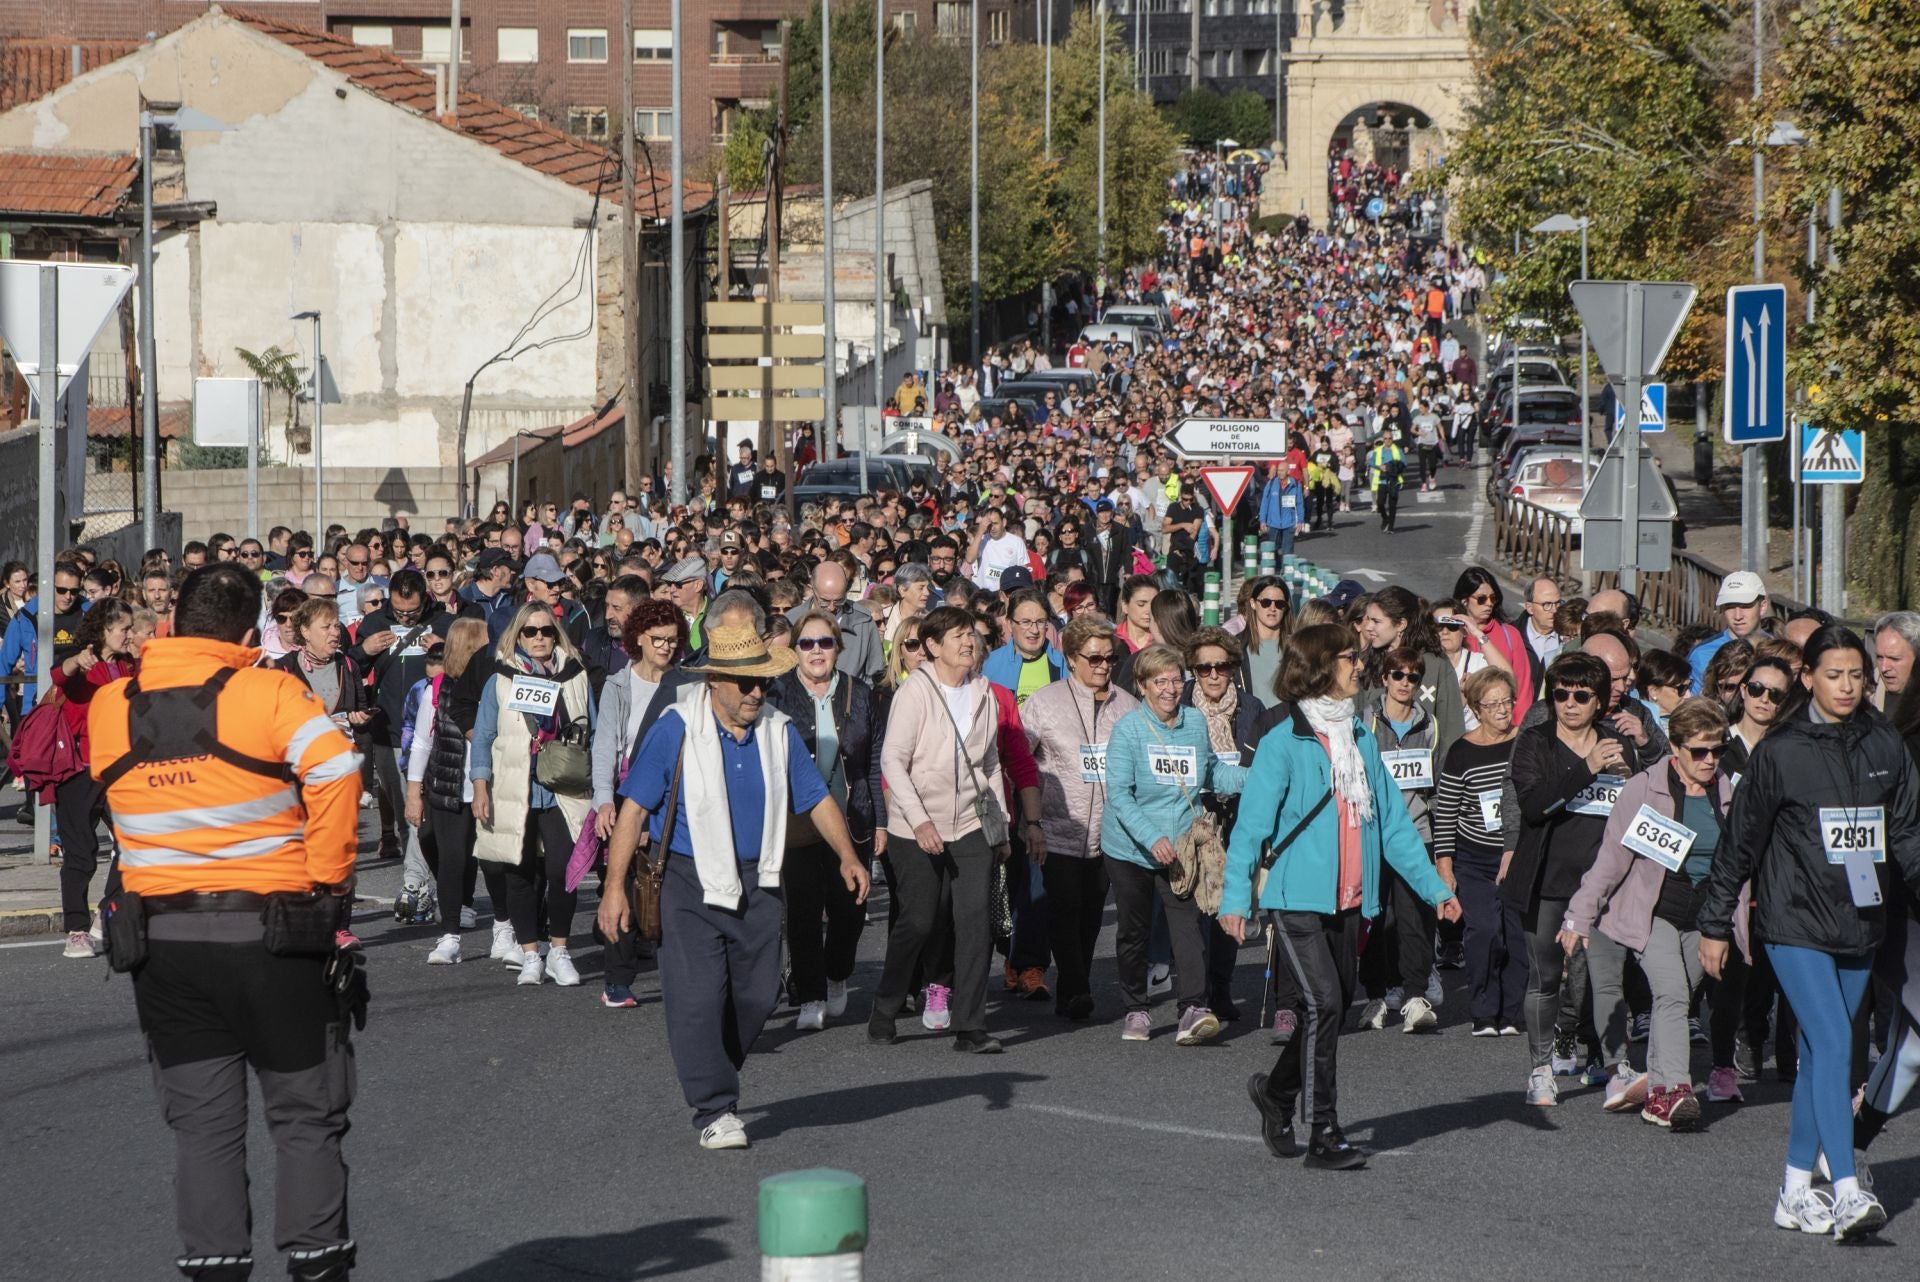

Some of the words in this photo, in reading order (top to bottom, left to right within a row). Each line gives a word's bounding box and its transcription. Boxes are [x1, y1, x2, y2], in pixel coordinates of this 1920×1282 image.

[893, 421, 924, 429] COMIDA
[1209, 424, 1260, 432] POLIGONO
[1211, 441, 1261, 450] HONTORIA
[515, 687, 552, 704] 6756
[1392, 761, 1423, 779] 2712
[148, 771, 197, 788] CIVIL
[1636, 821, 1683, 855] 6364
[1830, 826, 1875, 848] 2931
